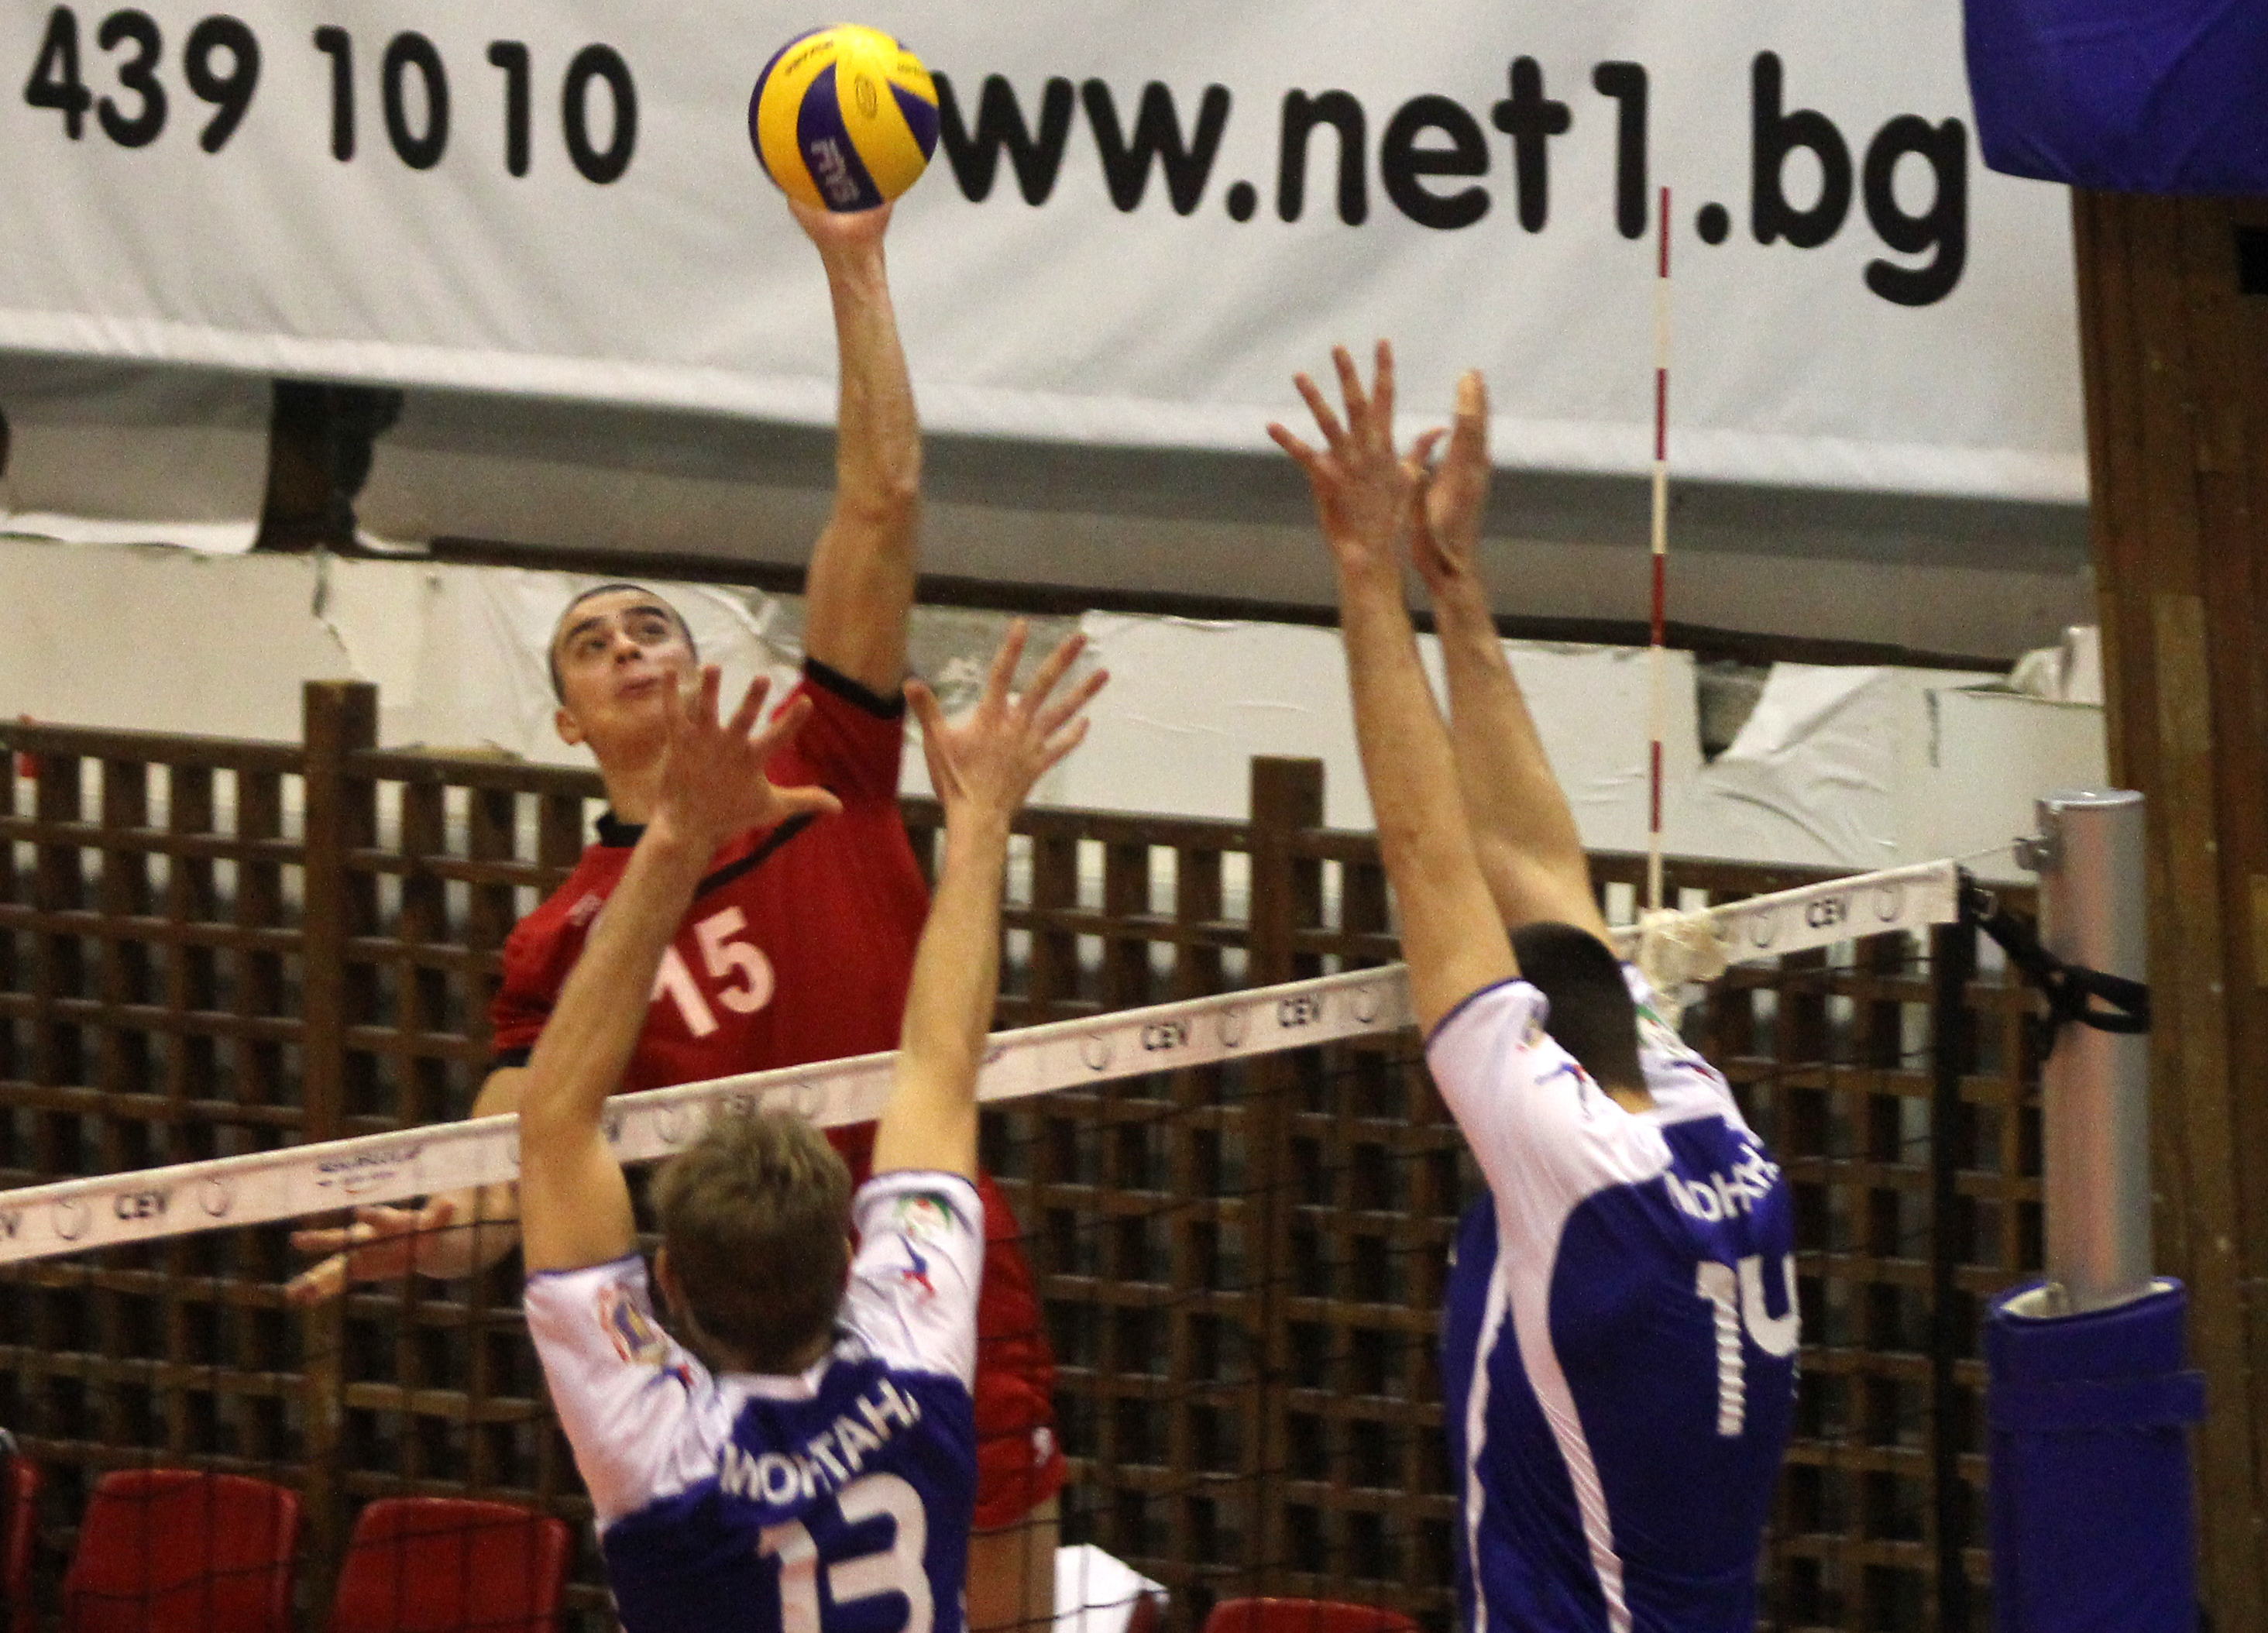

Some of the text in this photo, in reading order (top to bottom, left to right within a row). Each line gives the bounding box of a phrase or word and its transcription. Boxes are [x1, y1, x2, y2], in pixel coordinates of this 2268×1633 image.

[24, 5, 260, 154] 439
[926, 50, 1968, 308] ww.net1.bg
[650, 906, 775, 1038] 15
[1806, 899, 1850, 928] CEV
[756, 1518, 936, 1633] 13
